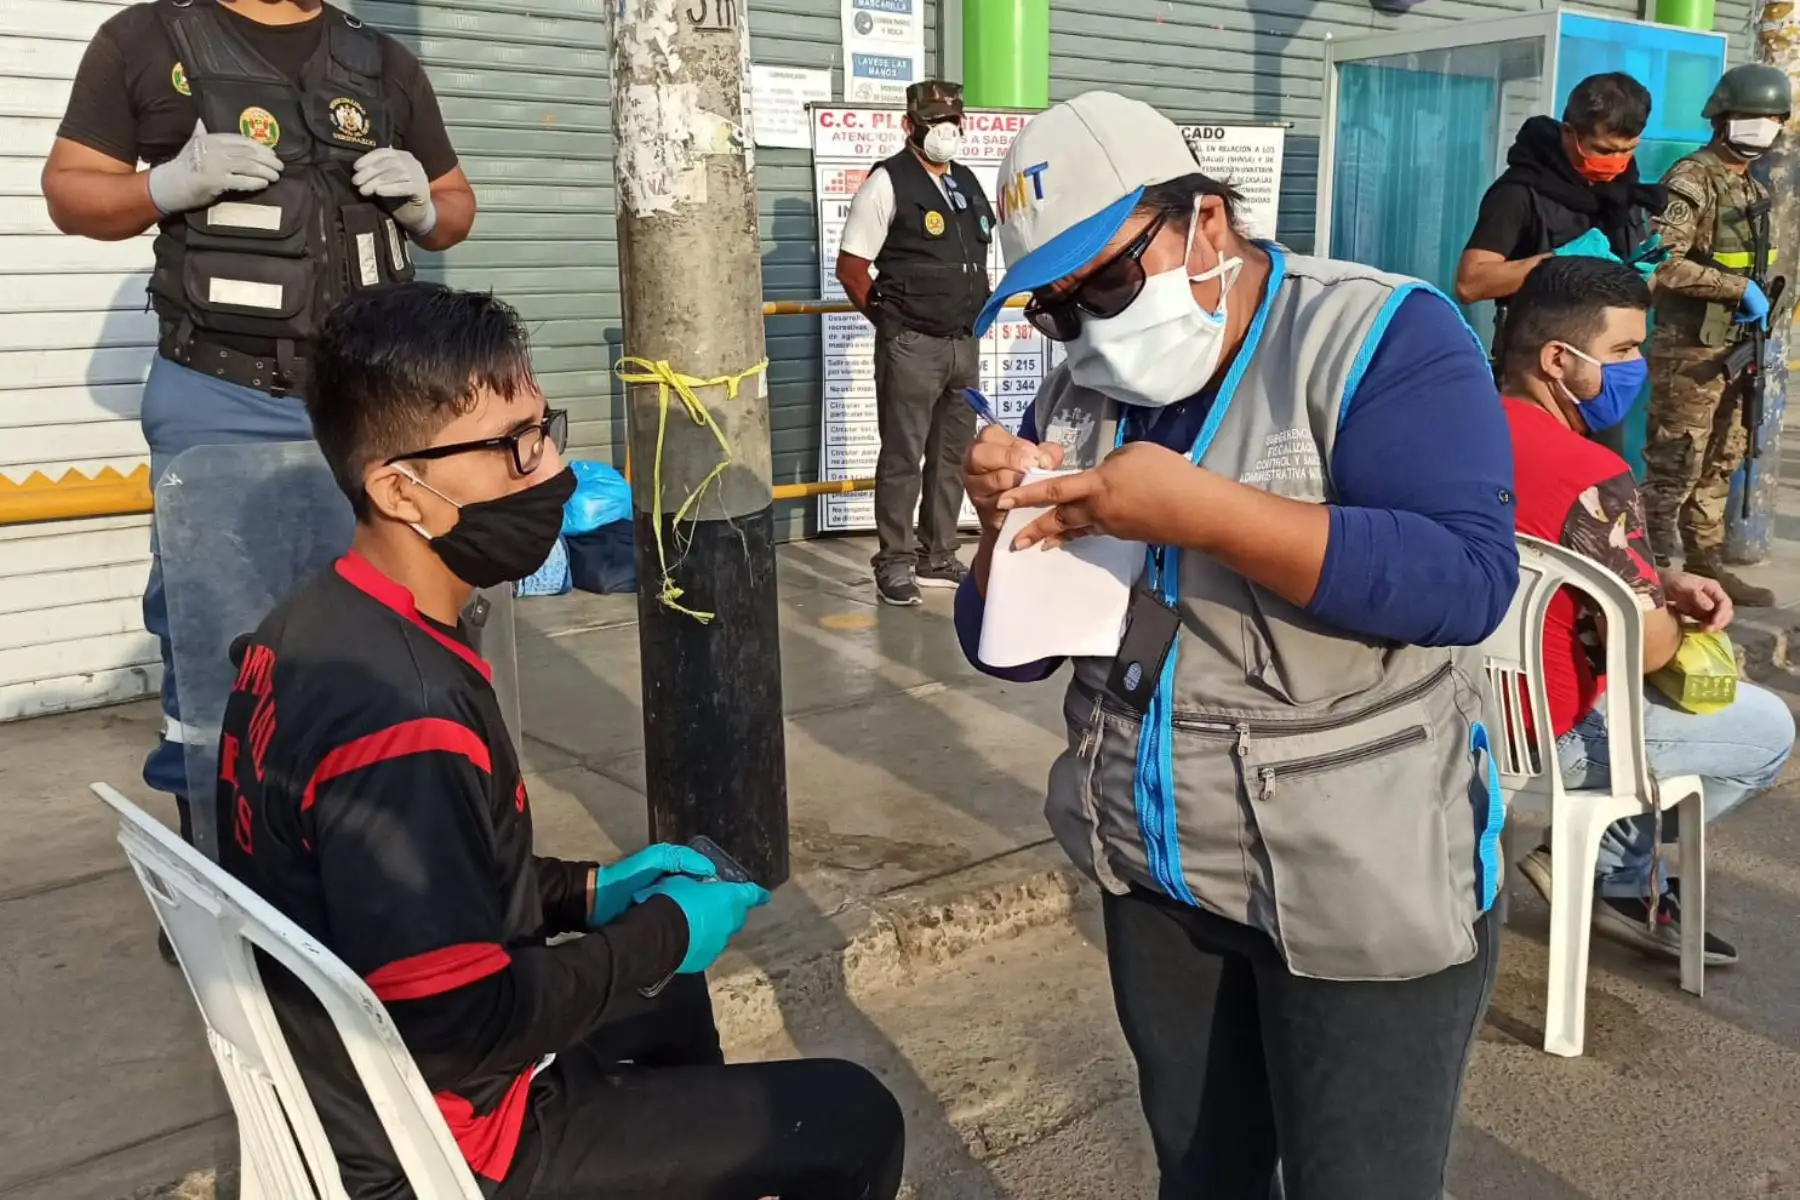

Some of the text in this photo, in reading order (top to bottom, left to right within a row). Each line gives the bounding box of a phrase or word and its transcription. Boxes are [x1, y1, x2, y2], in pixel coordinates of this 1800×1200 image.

[868, 66, 897, 77] MANOS
[820, 112, 864, 128] C.C.
[872, 113, 900, 129] PL
[1181, 127, 1225, 139] CADO
[983, 135, 1015, 145] SABA
[1016, 359, 1035, 371] 215
[1016, 380, 1035, 391] 344
[1016, 401, 1028, 412] 34
